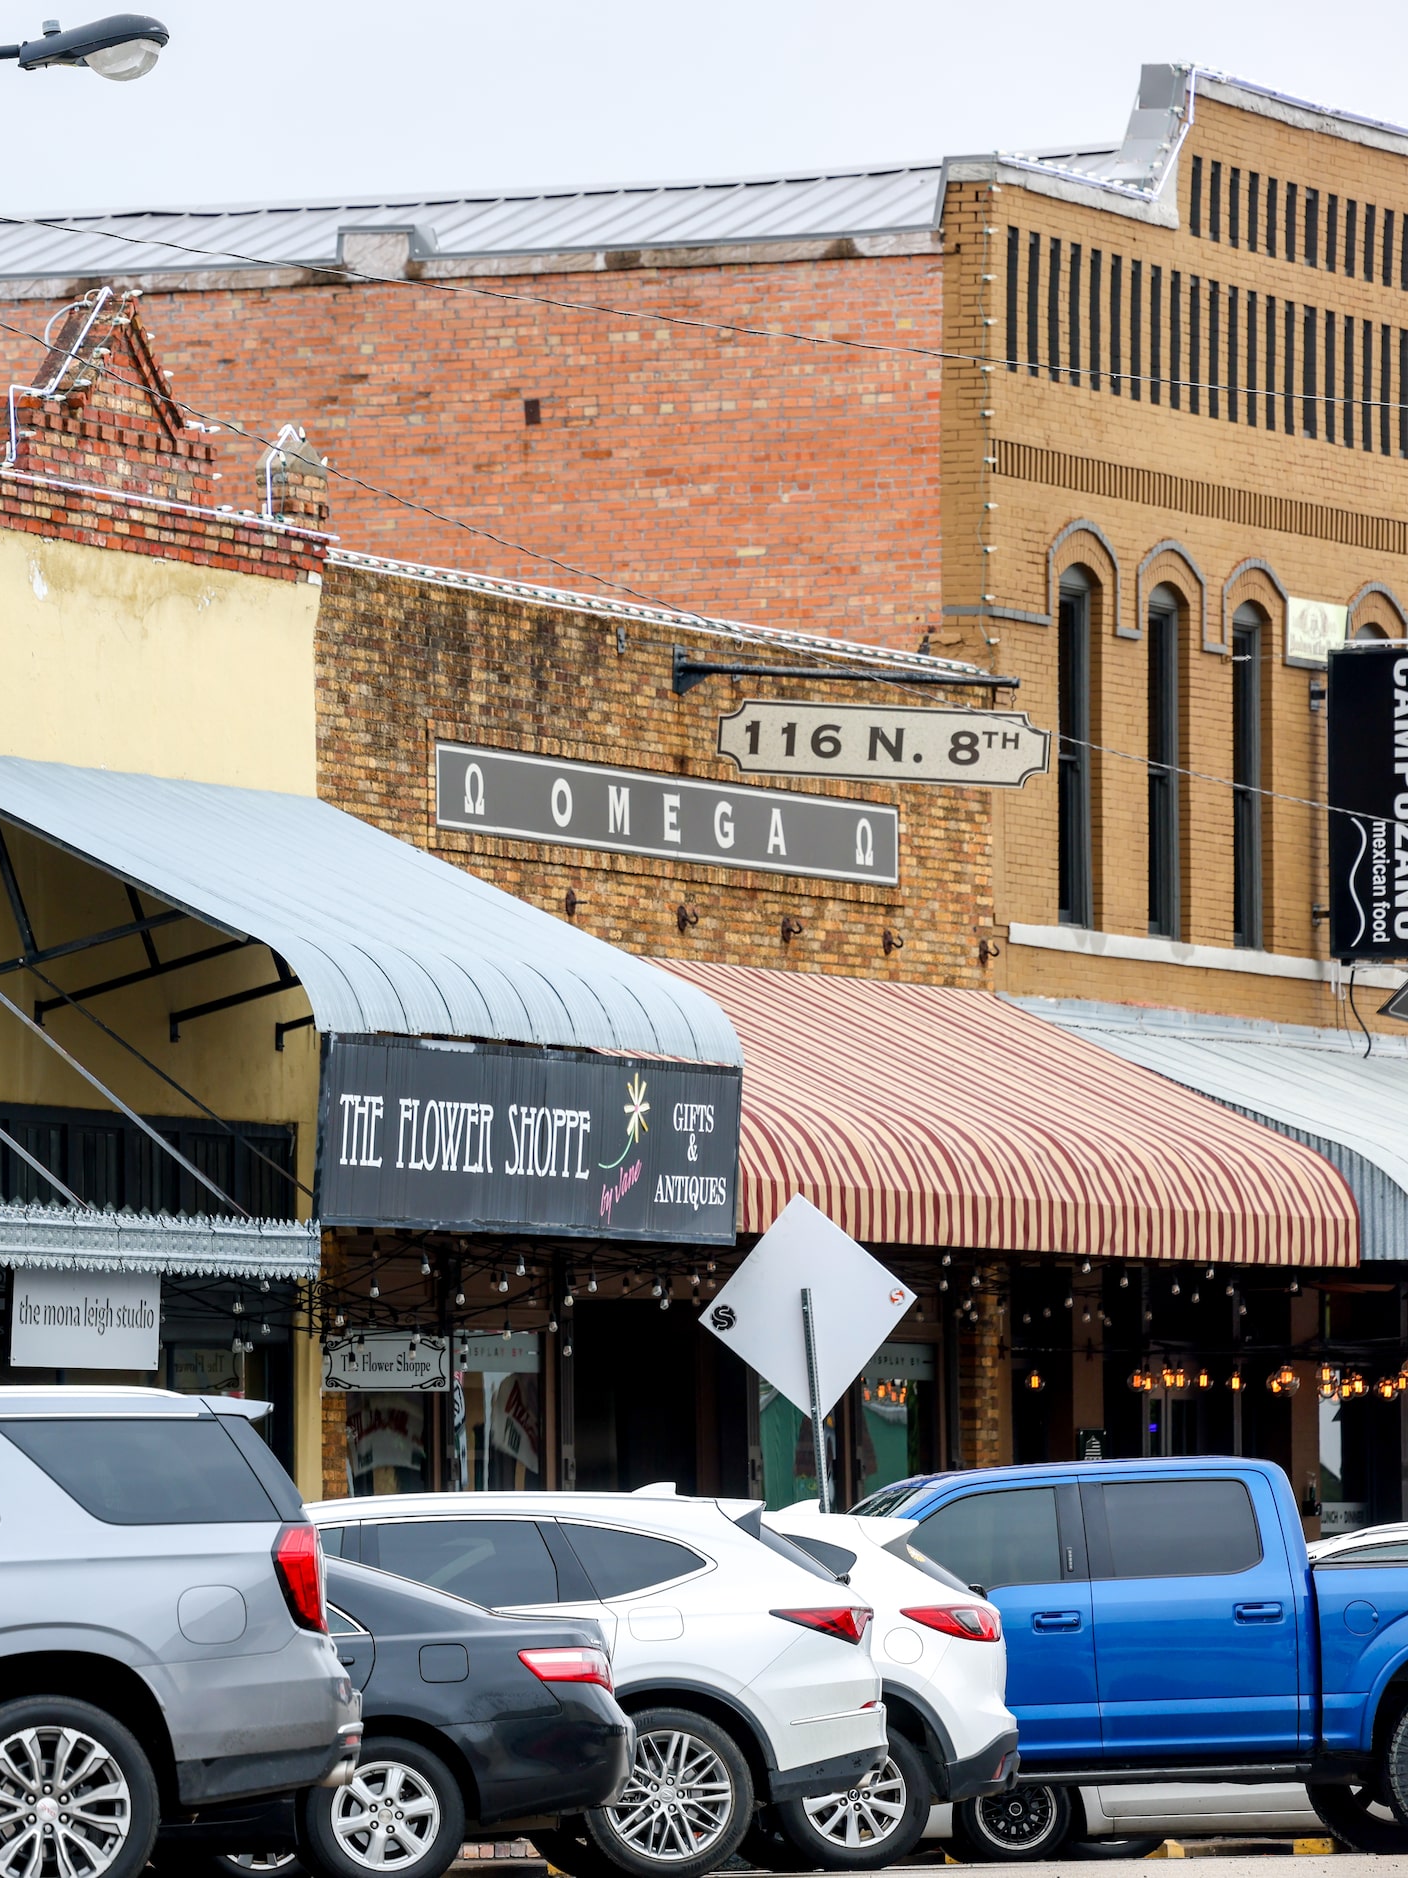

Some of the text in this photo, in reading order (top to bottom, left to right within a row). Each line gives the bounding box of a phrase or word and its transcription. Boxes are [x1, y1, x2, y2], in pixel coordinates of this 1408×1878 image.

[744, 720, 842, 758] 116
[867, 726, 923, 763] N.
[550, 777, 788, 857] OMEGA
[1372, 821, 1391, 942] mexican food
[339, 1094, 591, 1180] THE FLOWER SHOPPE
[673, 1102, 715, 1134] GIFTS
[687, 1133, 698, 1162] &
[600, 1184, 613, 1225] by
[654, 1175, 727, 1211] ANTIQUES
[19, 1294, 155, 1336] the mona leigh studio
[340, 1351, 431, 1377] Te Flower Shoppe
[468, 1347, 506, 1357] ISPLAY
